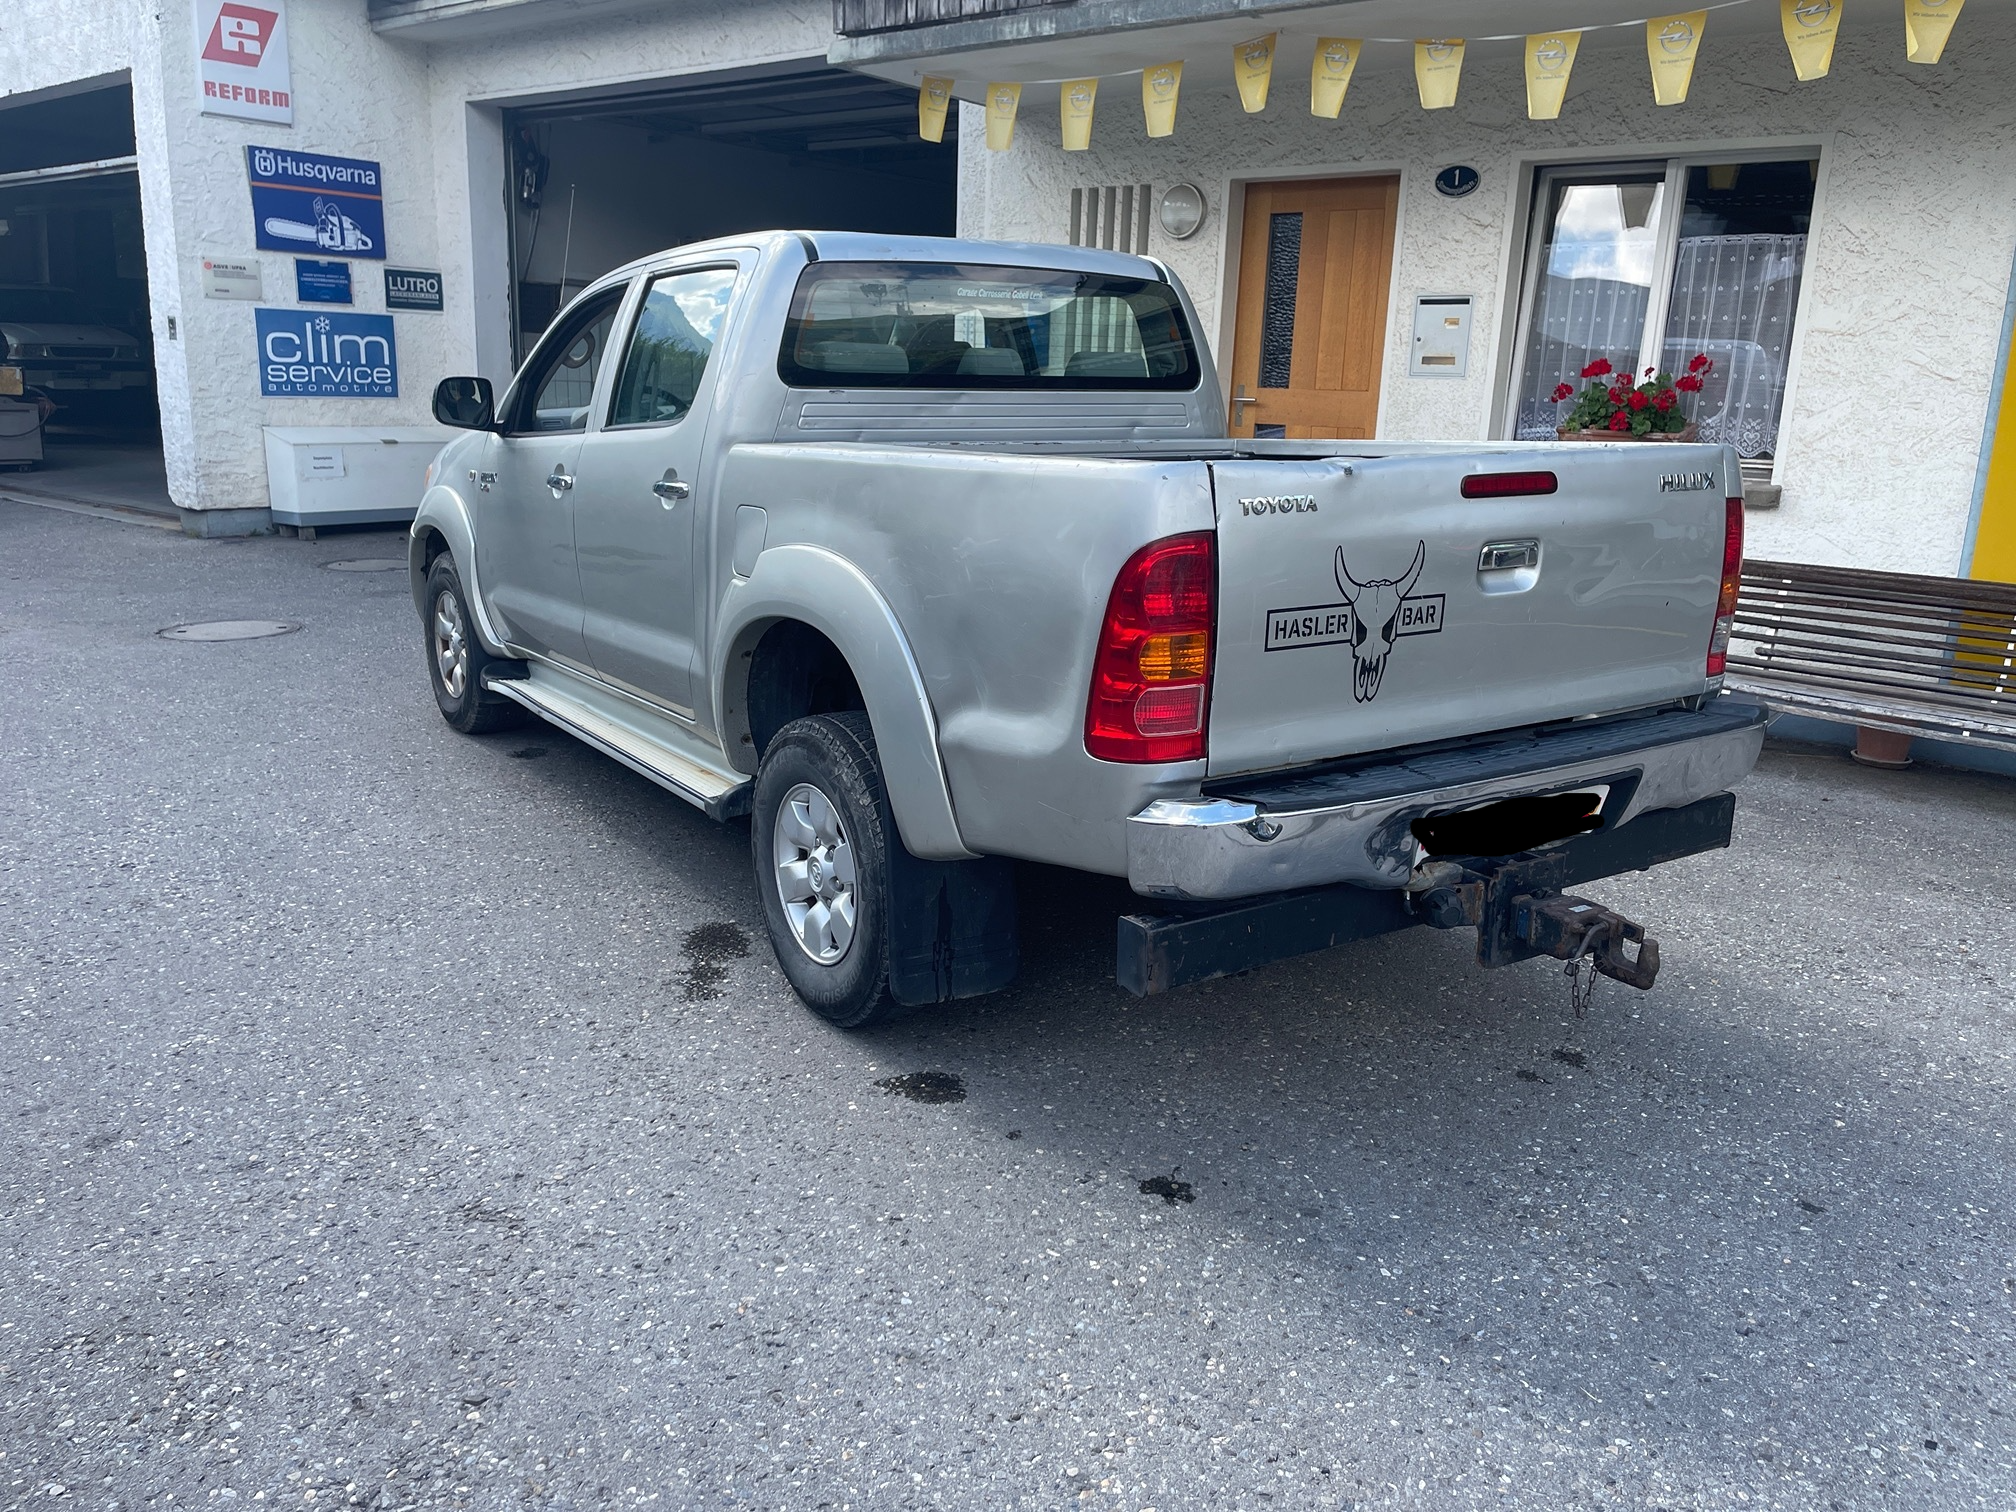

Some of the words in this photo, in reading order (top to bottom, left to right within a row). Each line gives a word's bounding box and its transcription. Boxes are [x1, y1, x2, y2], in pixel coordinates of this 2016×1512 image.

[204, 80, 290, 108] REFORM
[277, 155, 376, 185] Husqvarna
[1454, 168, 1460, 186] 1
[388, 275, 439, 293] LUTRO
[265, 315, 390, 366] clim
[267, 361, 392, 384] service
[268, 382, 393, 393] automotive
[1659, 471, 1716, 492] HILUX
[1238, 494, 1318, 516] TOYOTA
[1274, 613, 1348, 641] HASLER
[1401, 605, 1436, 627] BAR
